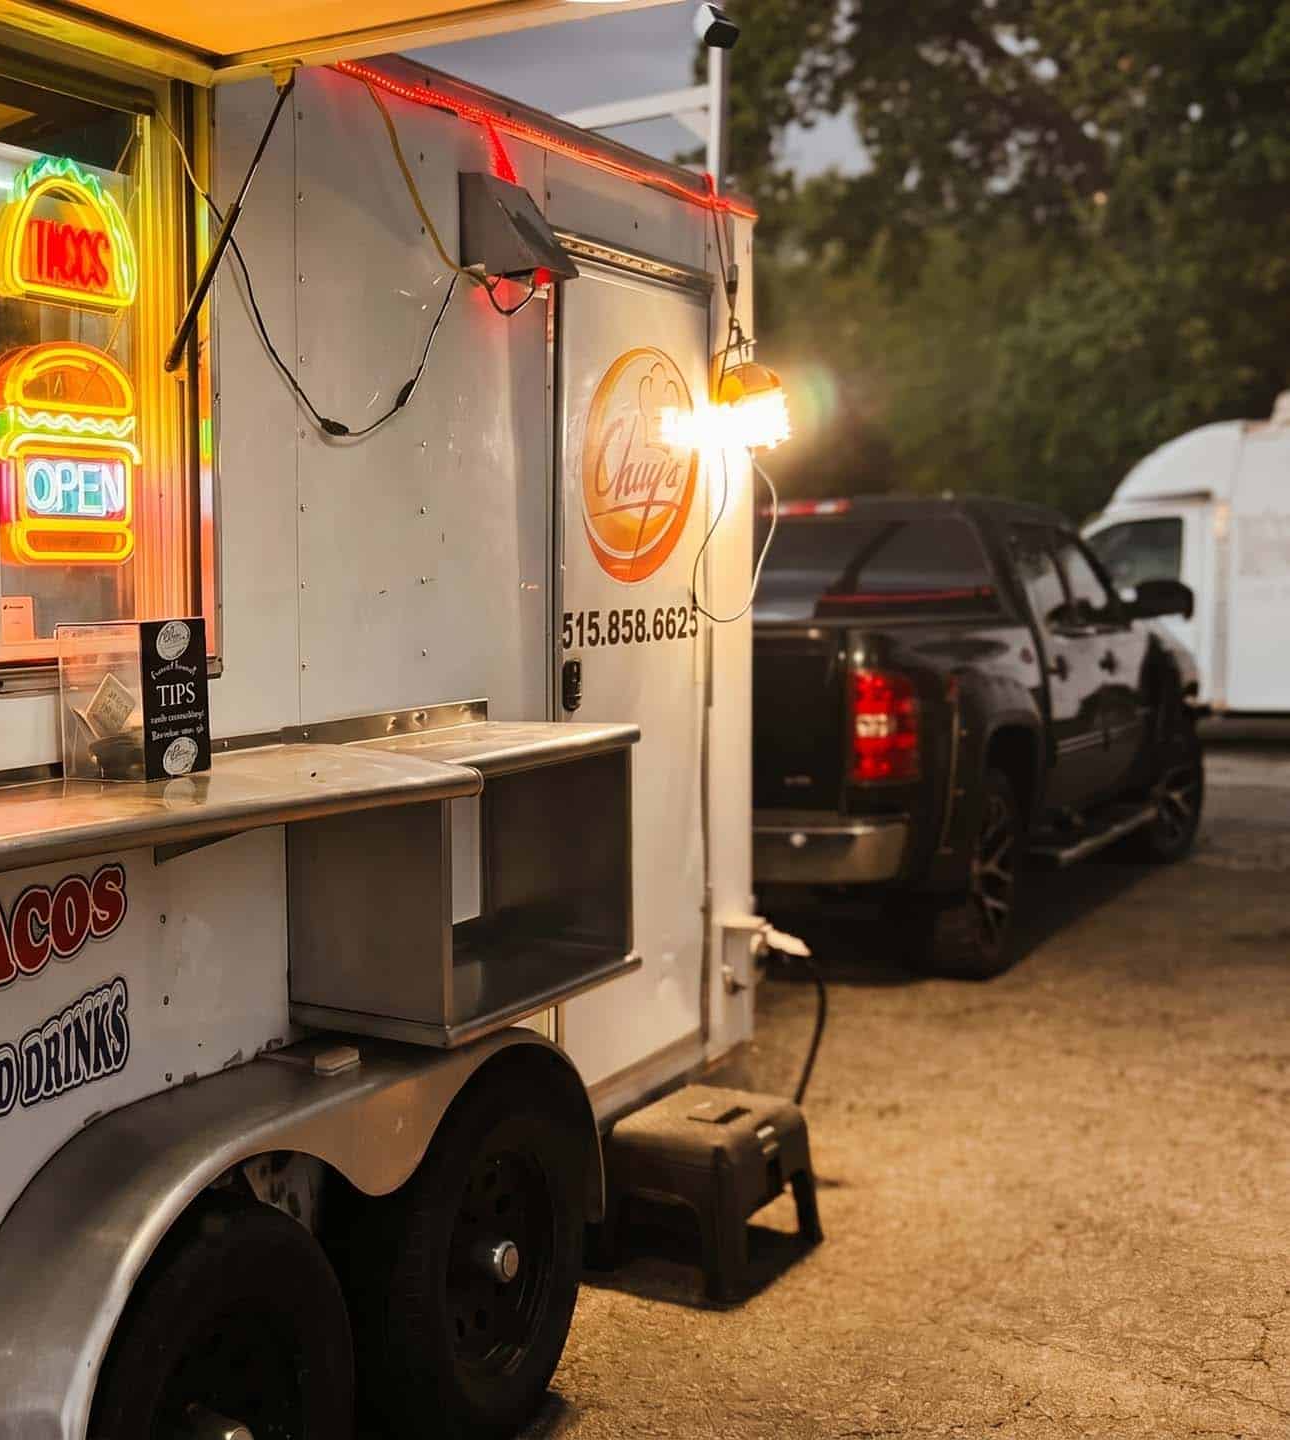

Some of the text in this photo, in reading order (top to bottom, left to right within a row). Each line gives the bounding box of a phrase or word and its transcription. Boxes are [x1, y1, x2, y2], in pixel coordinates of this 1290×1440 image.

[30, 220, 110, 287] TACOS
[26, 457, 125, 518] OPEN
[595, 413, 683, 502] Chuy's
[562, 605, 700, 651] 515.858.6625
[155, 681, 197, 708] TIPS
[20, 977, 130, 1107] DRINKS
